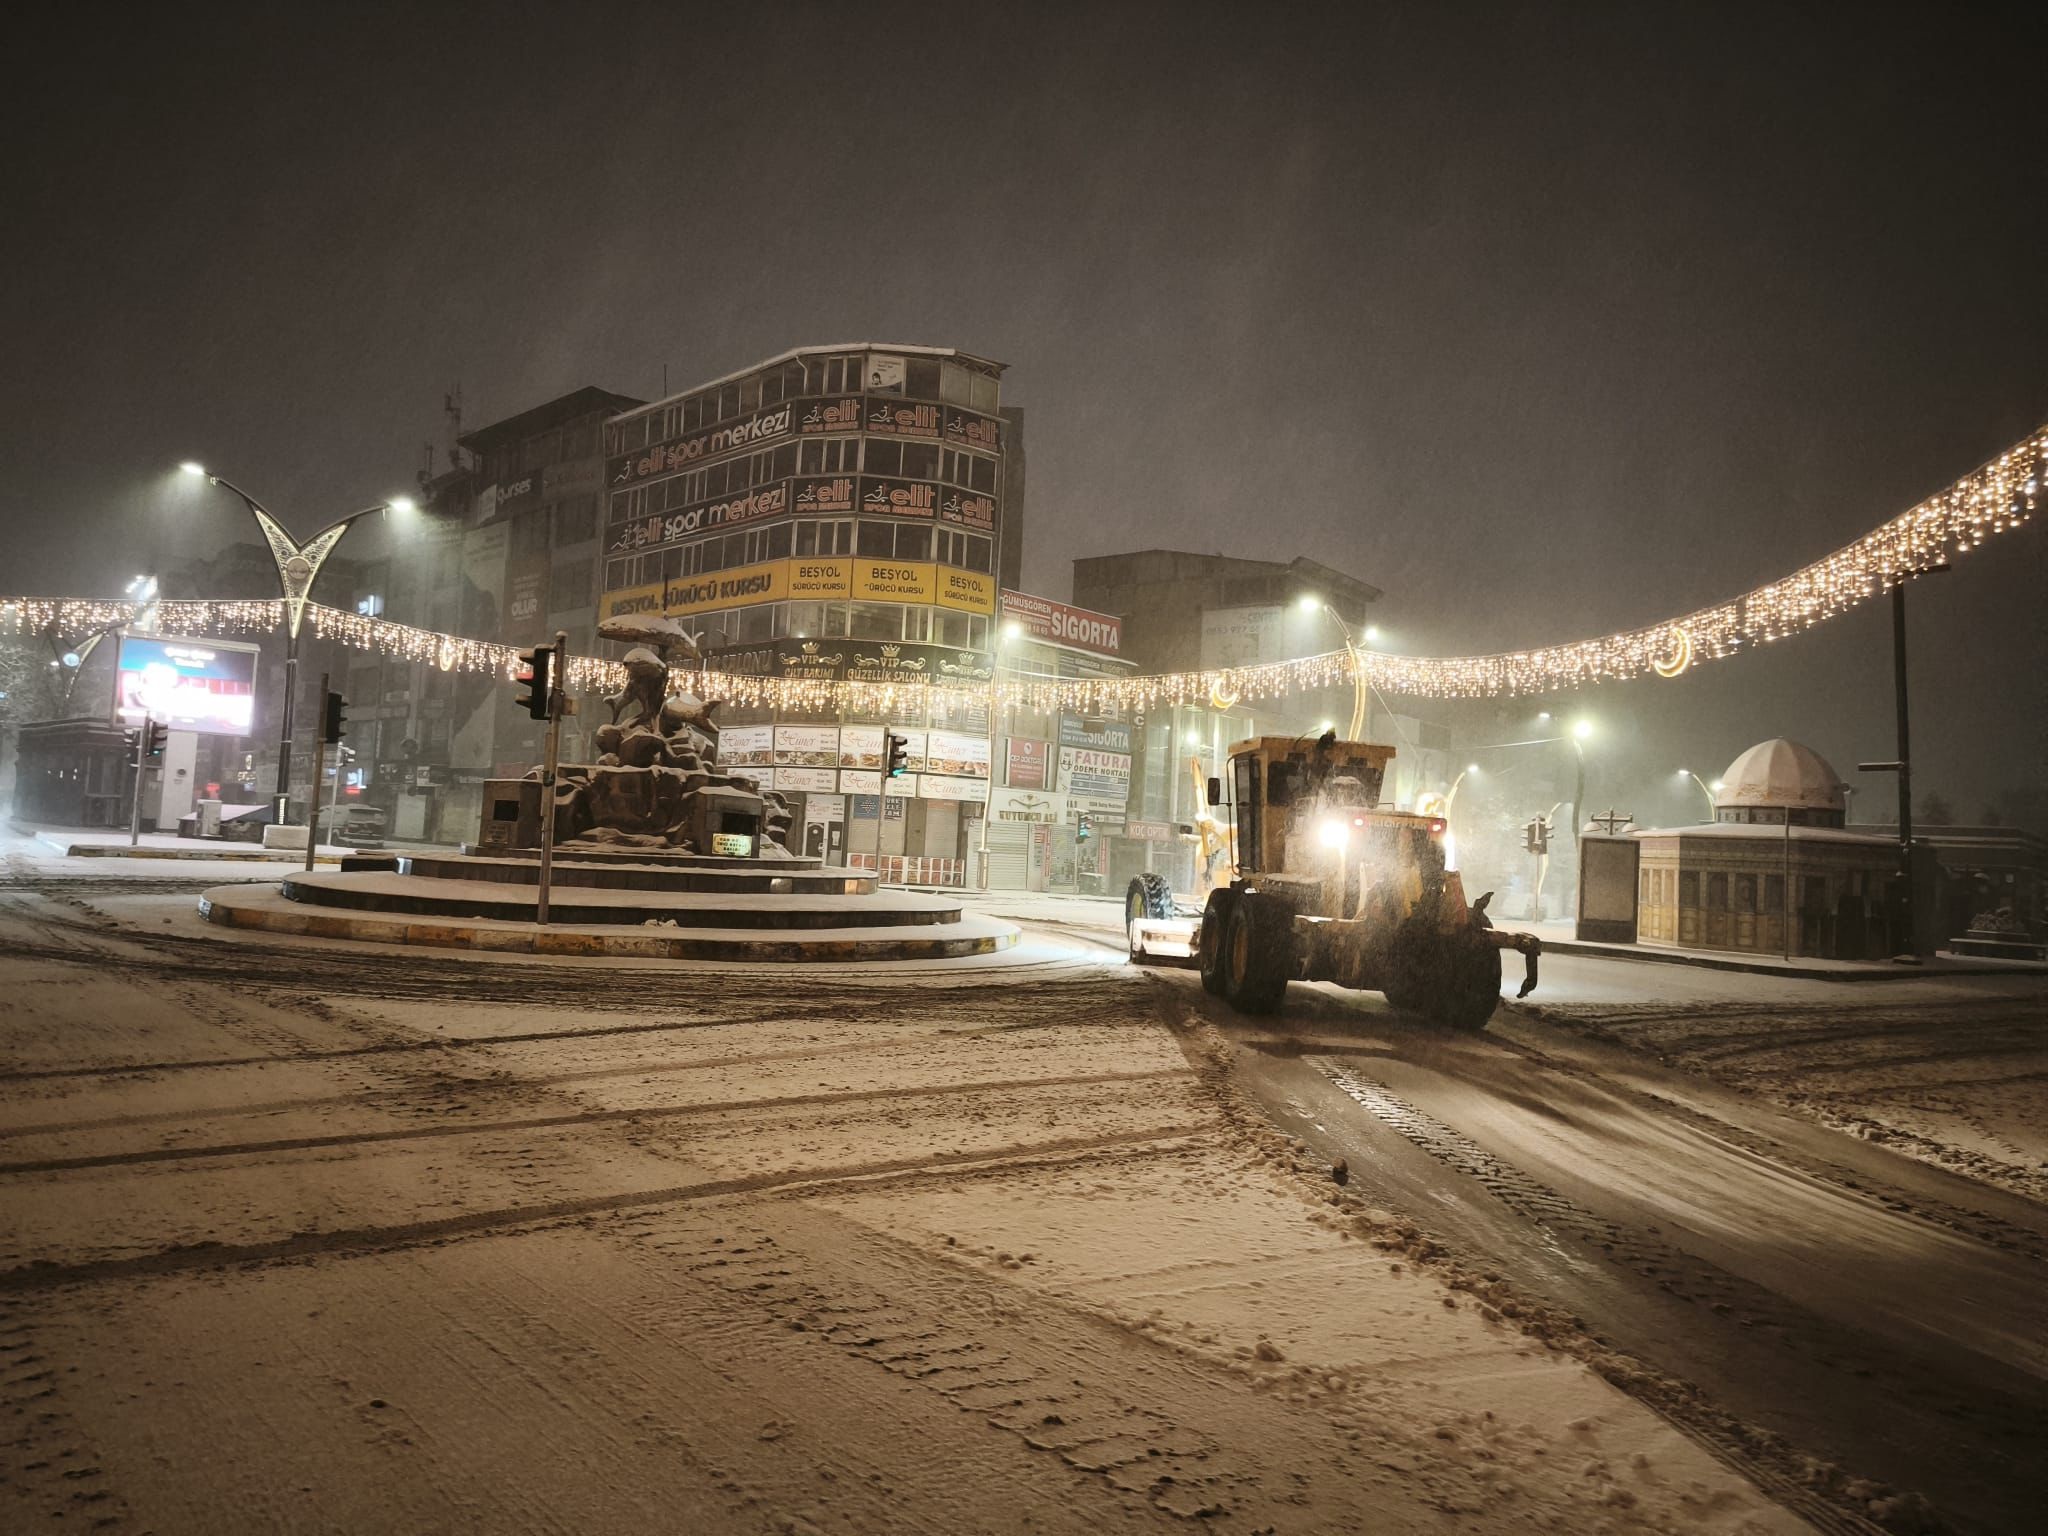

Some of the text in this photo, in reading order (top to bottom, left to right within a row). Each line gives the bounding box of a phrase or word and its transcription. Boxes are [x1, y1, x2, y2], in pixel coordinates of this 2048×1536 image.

[823, 399, 861, 422] elit
[894, 404, 941, 428] elit
[637, 445, 666, 476] elit
[666, 435, 708, 472] spor
[711, 403, 792, 452] merkezi
[965, 418, 999, 443] elit
[816, 479, 853, 501] elit
[890, 484, 936, 507] elit
[636, 481, 787, 545] elit spor merkezi
[961, 496, 995, 521] elit
[800, 566, 841, 579] BEŞYOL
[872, 567, 918, 582] BEŞYOL
[950, 575, 984, 593] BEŞYOL
[720, 573, 772, 598] KURSU
[822, 582, 846, 591] KURSU
[1051, 607, 1119, 650] SİGORTA
[893, 671, 931, 684] SALONU
[1075, 750, 1129, 769] FATURA
